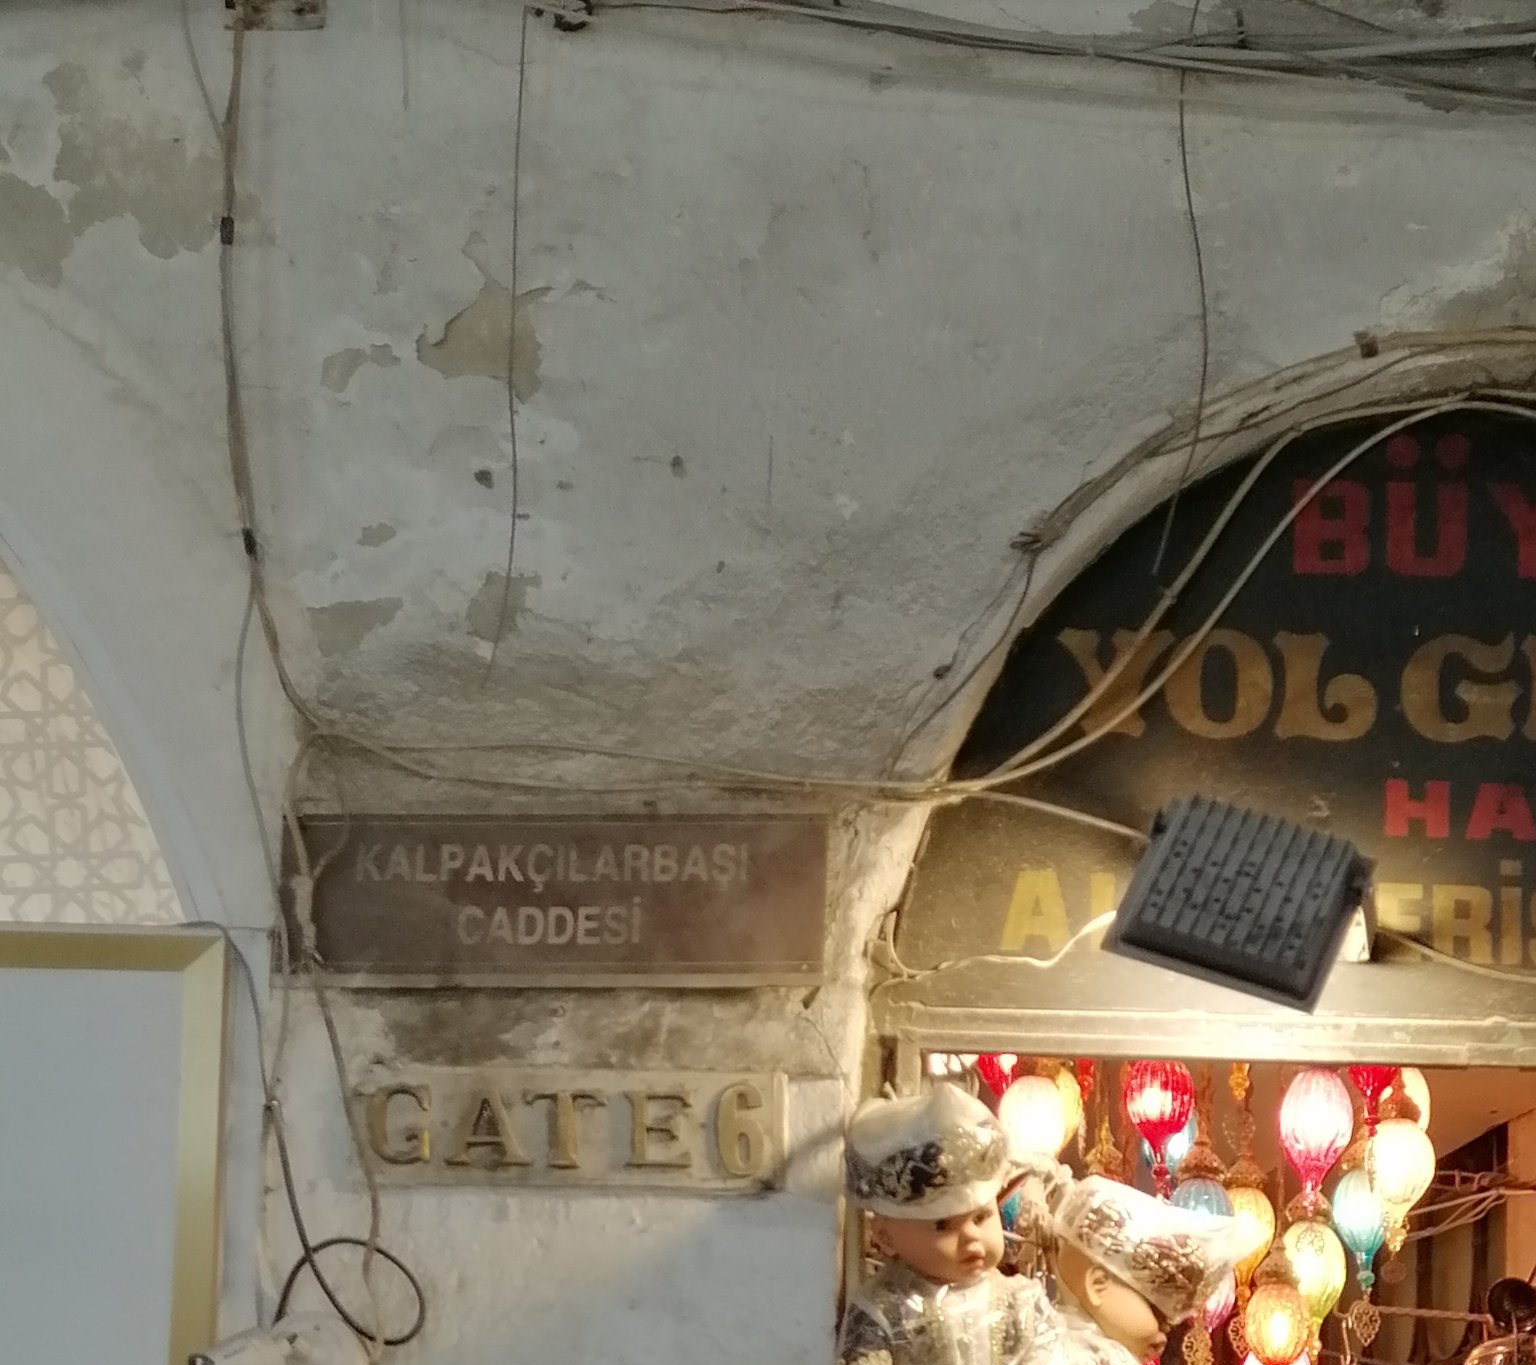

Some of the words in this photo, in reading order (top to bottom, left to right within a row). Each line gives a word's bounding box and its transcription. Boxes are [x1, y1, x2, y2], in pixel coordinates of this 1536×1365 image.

[354, 843, 750, 896] KALPAKÇILARBAŞI
[456, 896, 642, 945] CADDESİ
[364, 1083, 693, 1169] GATE
[714, 1083, 769, 1177] 6
